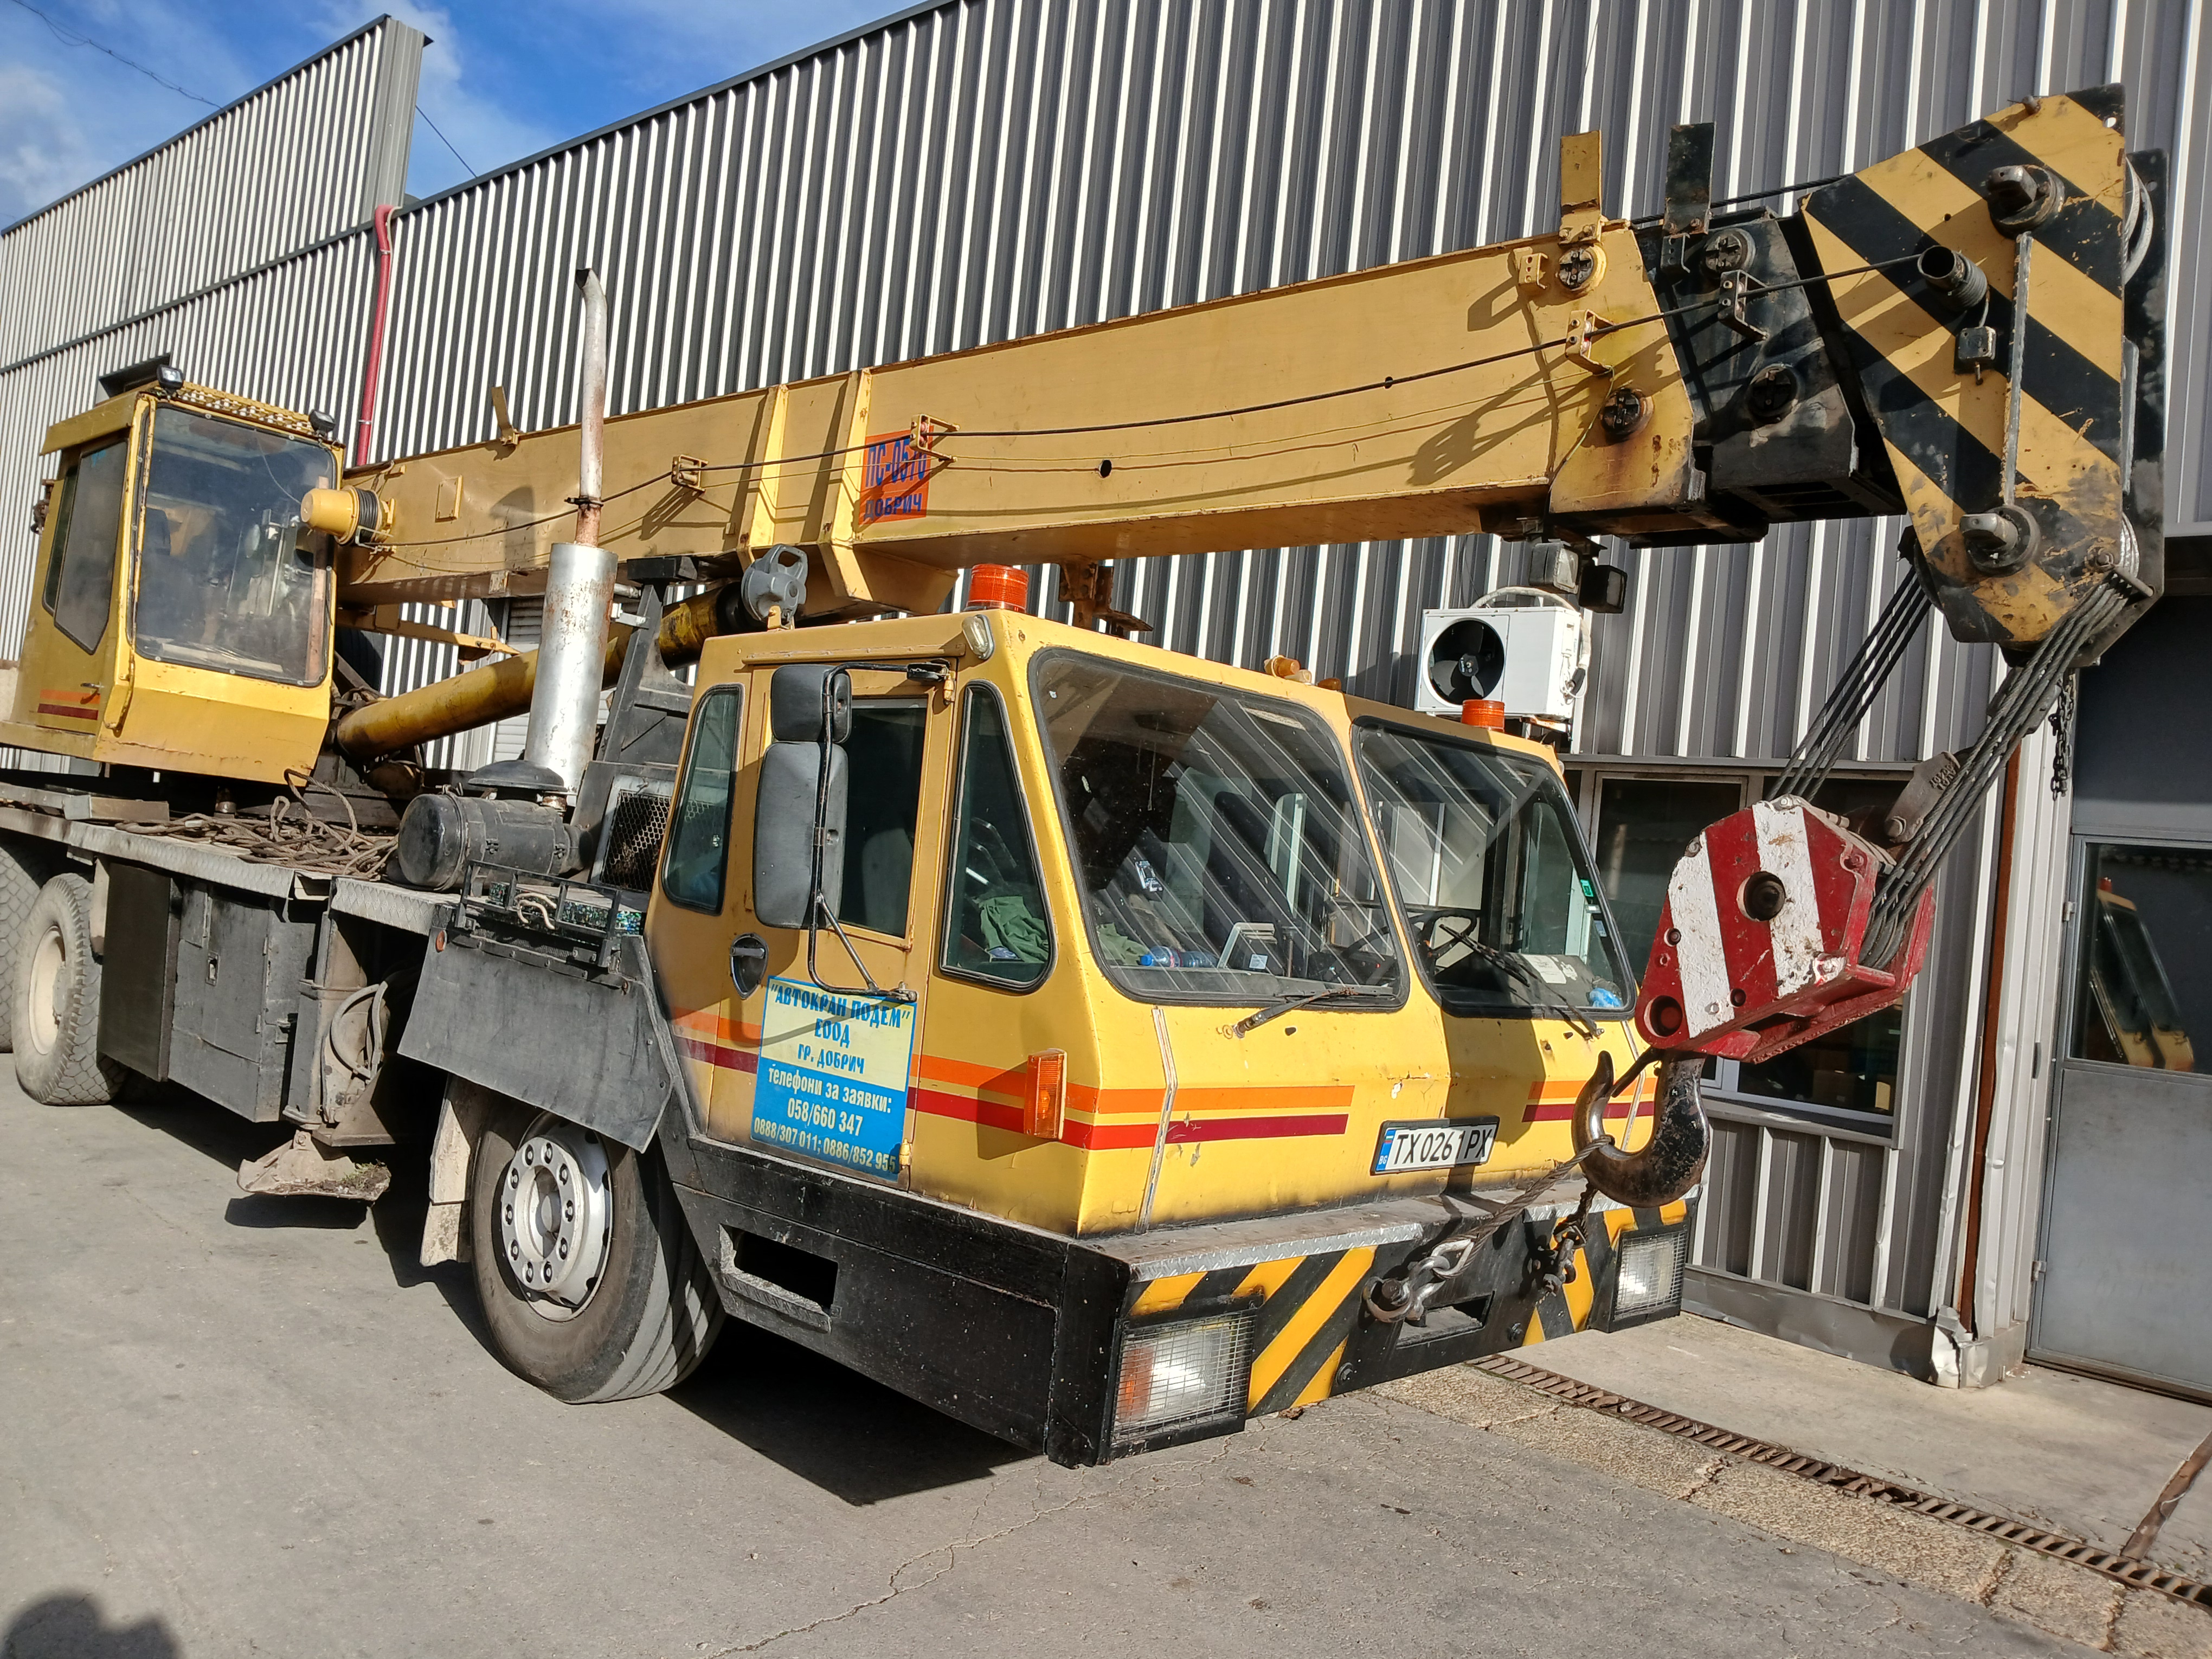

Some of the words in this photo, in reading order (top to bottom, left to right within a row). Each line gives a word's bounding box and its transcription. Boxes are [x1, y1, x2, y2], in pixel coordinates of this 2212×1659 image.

[863, 493, 922, 522] ДОБРИЧ
[770, 983, 847, 1017] "АВТОКРАН
[851, 1000, 911, 1028] ПОДЕМ"
[814, 1018, 851, 1049] ЕООД
[798, 1044, 814, 1063] ГР.
[817, 1049, 865, 1074] ДОБРИЧ
[768, 1066, 822, 1096] телефони
[826, 1082, 839, 1100] за
[842, 1086, 892, 1113] заявки:
[787, 1097, 836, 1129] 058/660
[839, 1111, 864, 1136] 347
[754, 1117, 800, 1144] 0888/307
[799, 1130, 822, 1154] 011;
[824, 1137, 873, 1167] 0886/852
[874, 1151, 896, 1173] 955
[1379, 1155, 1387, 1165] BG
